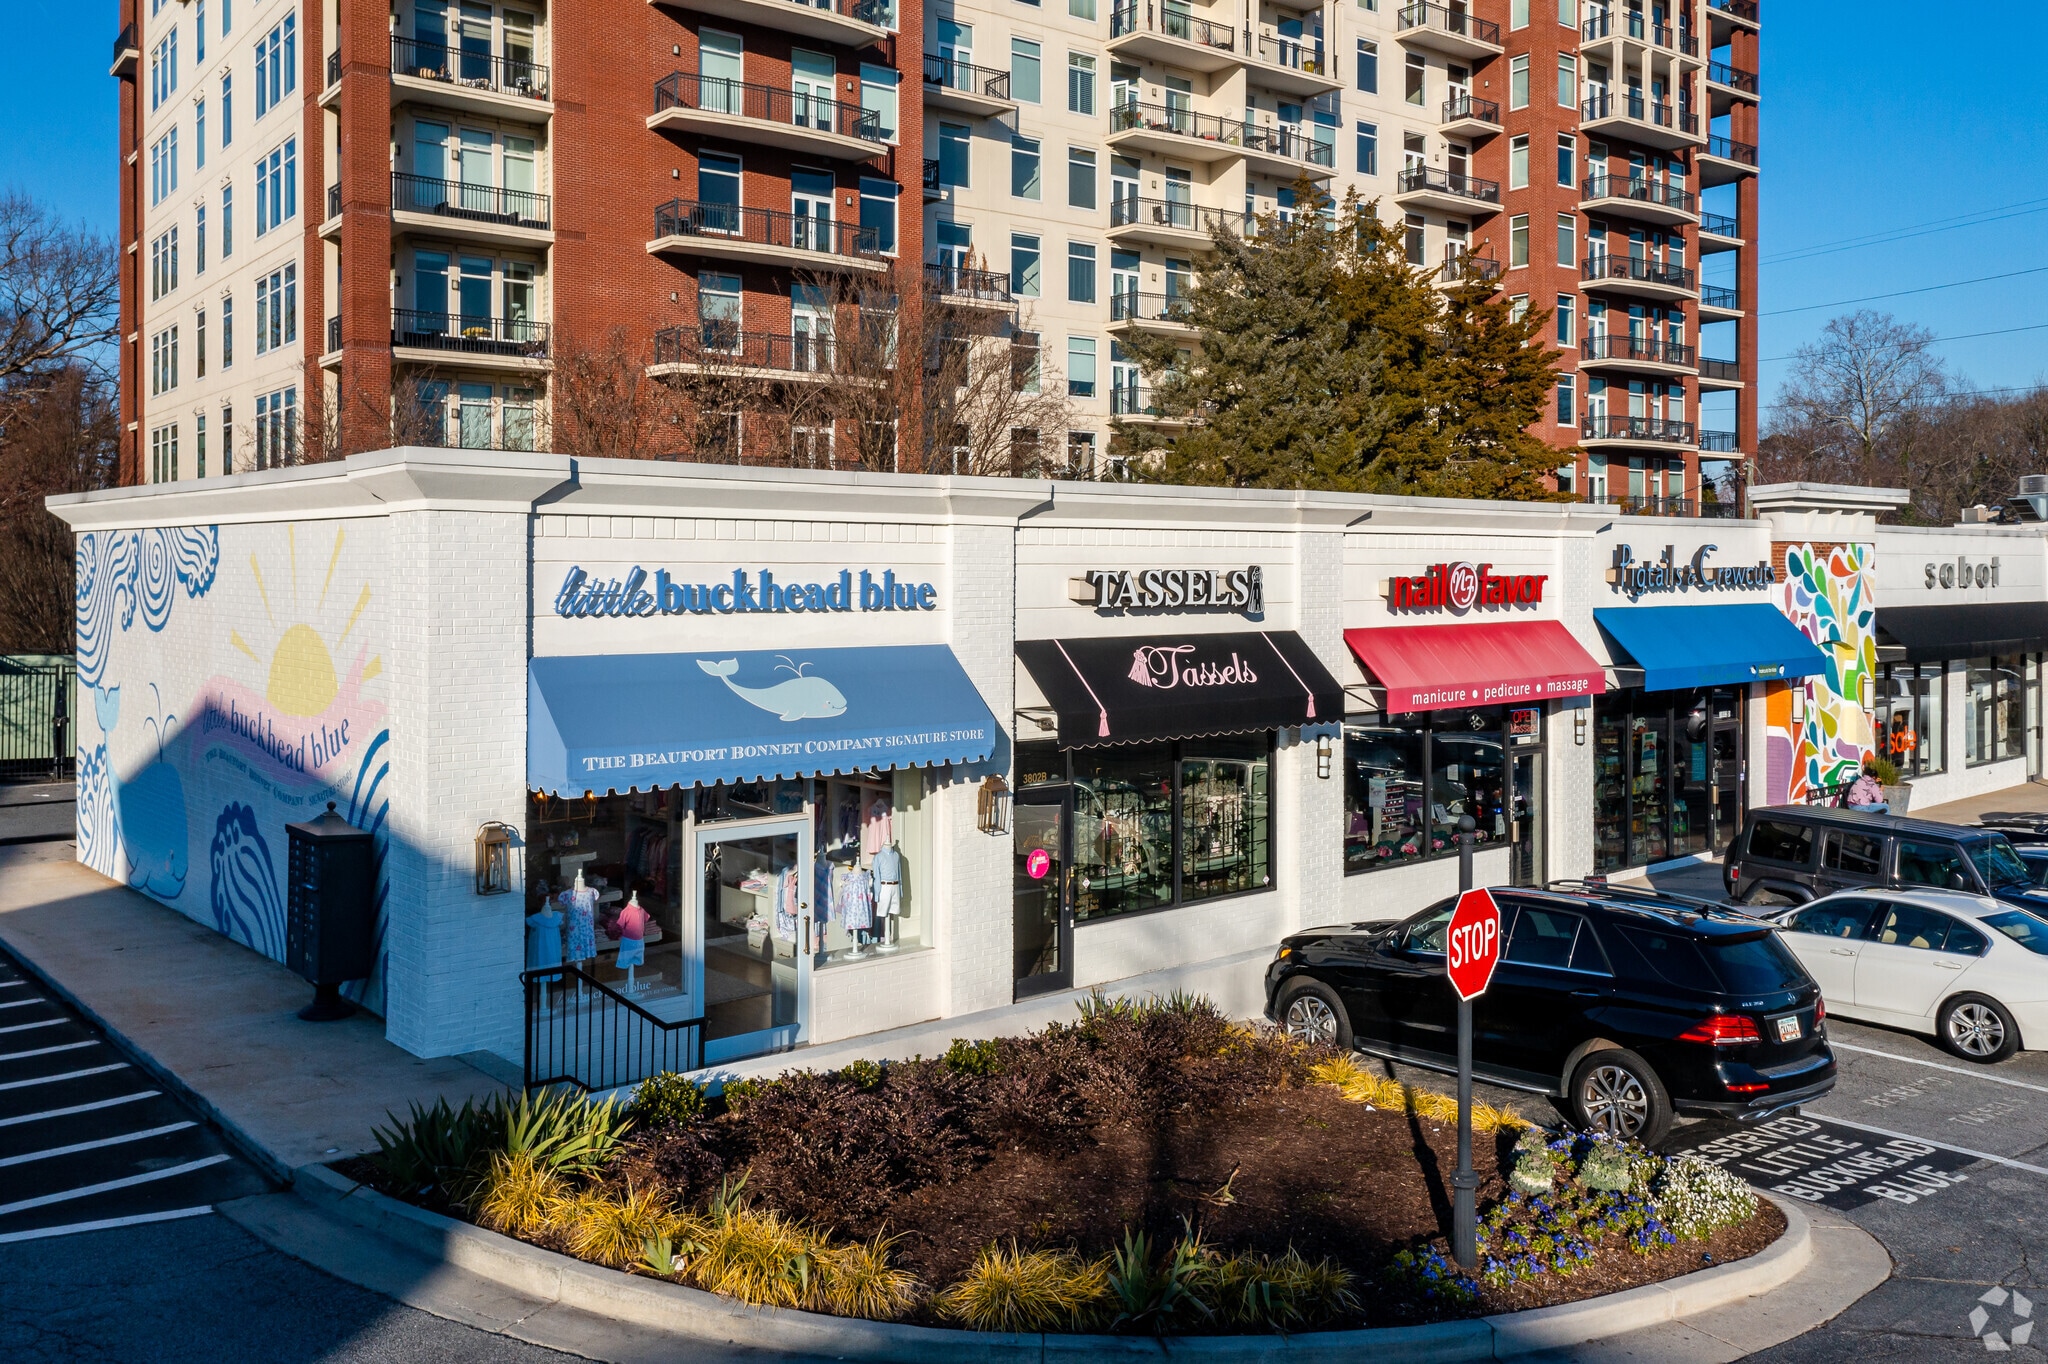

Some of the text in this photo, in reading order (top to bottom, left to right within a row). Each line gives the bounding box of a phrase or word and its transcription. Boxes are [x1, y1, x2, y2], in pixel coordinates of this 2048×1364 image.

[554, 564, 938, 615] little buckhead blue
[1091, 568, 1250, 608] TASSELS
[1393, 563, 1448, 608] nail
[1480, 563, 1549, 605] favor
[1620, 544, 1776, 596] Pigtails & Crewcuts
[1924, 556, 2001, 589] sabot
[1147, 644, 1258, 689] Tassels
[1412, 678, 1588, 705] manicure pedicure massage
[202, 691, 351, 773] little buckhead blue
[582, 729, 984, 771] THE BEAUFORT BONNET COMPANY SIGNATURE STORE
[1889, 725, 1918, 754] sale
[1023, 771, 1047, 784] 3802B
[1451, 917, 1496, 969] STOP
[1671, 1116, 1822, 1167] ESERVED
[1738, 1134, 1863, 1177] LITTLE
[1769, 1139, 1937, 1201] BUCKHEAD
[1862, 1164, 1969, 1204] BLUE
